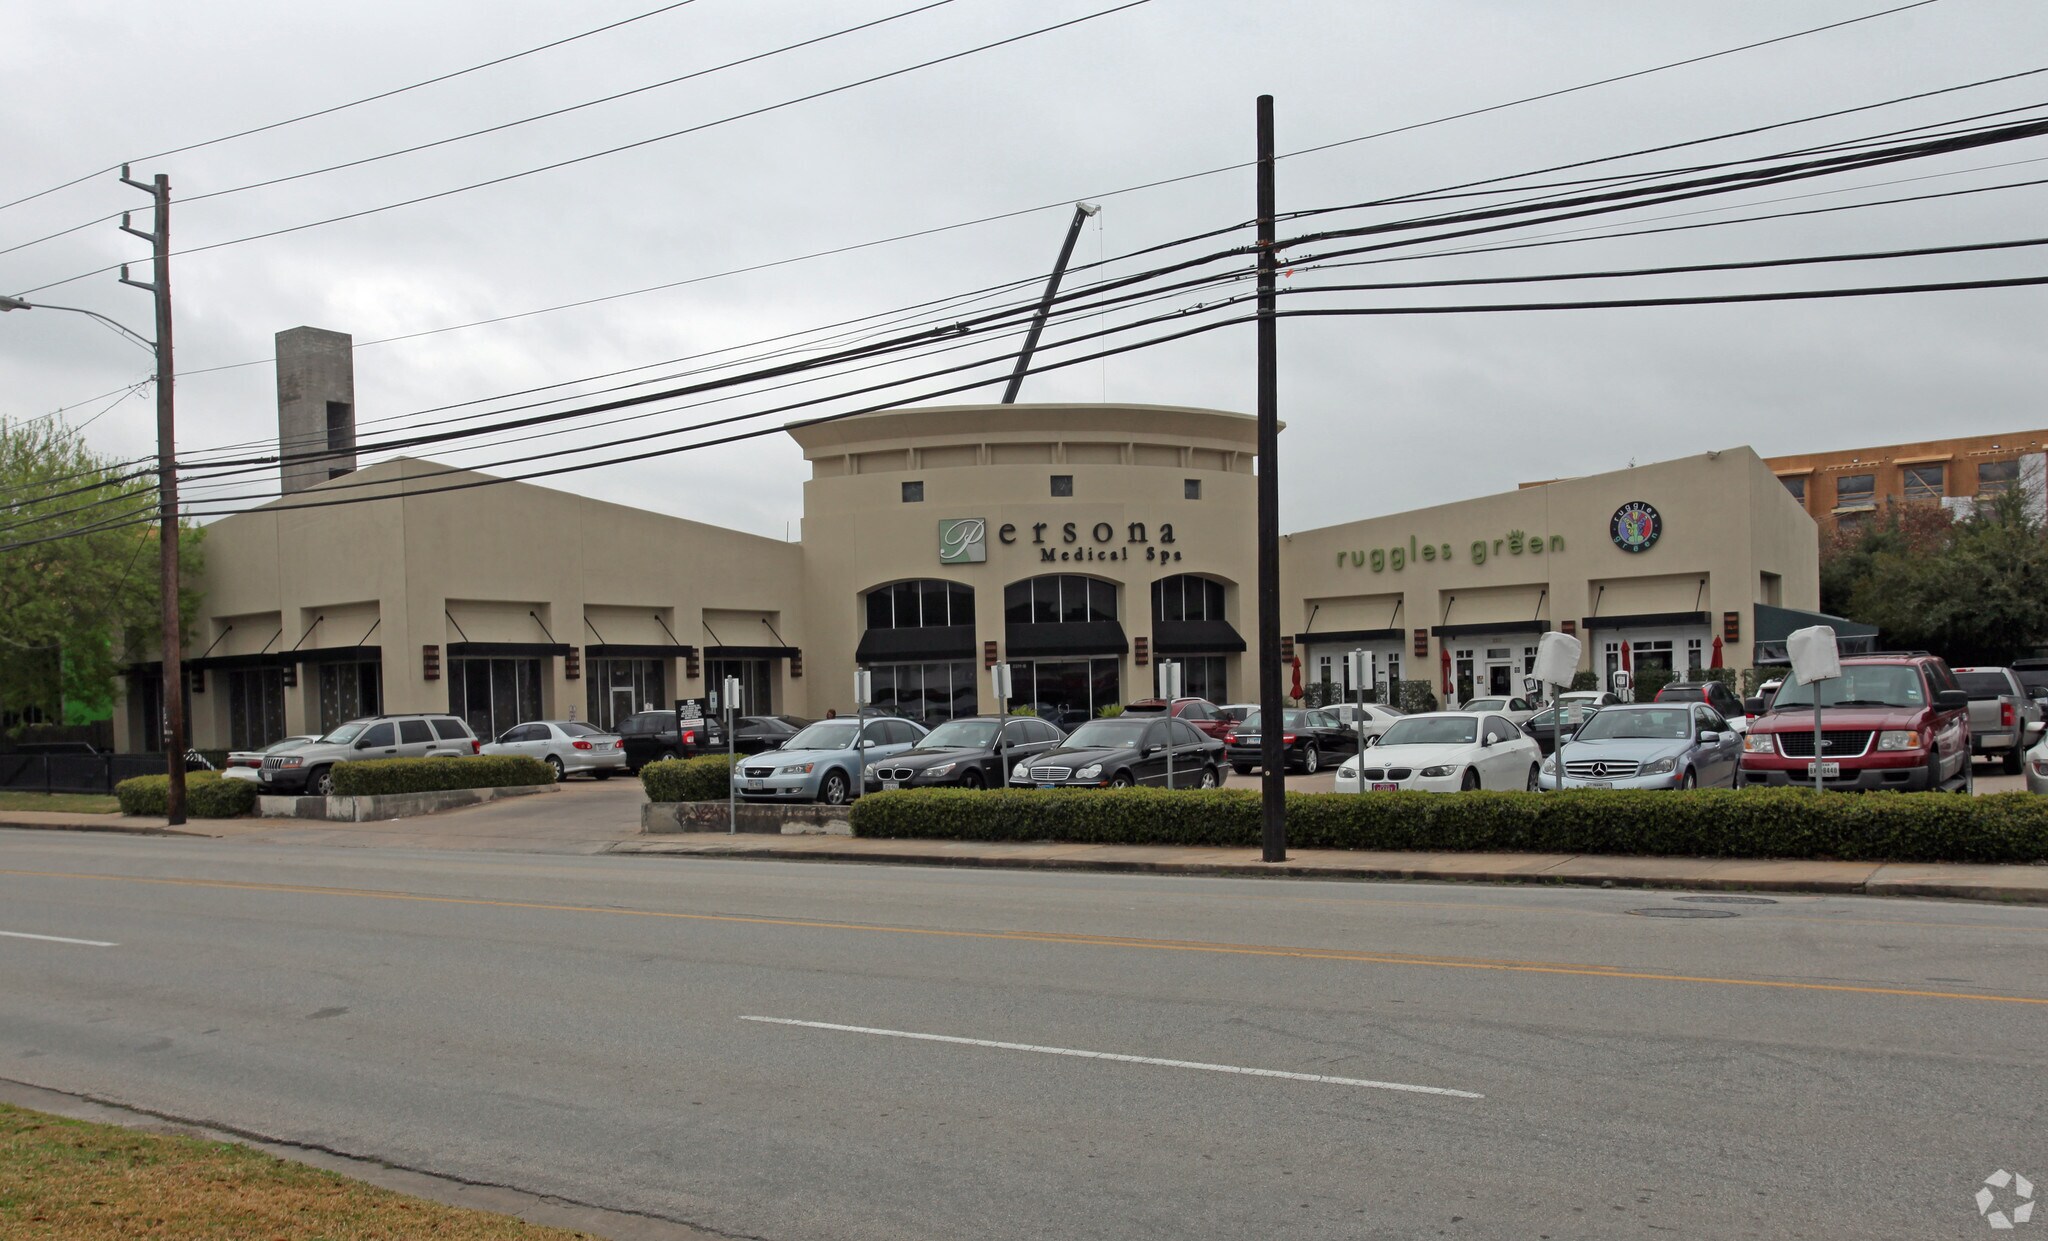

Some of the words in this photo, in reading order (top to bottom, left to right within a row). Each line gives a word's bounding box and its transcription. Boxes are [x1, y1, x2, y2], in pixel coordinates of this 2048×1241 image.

[1614, 503, 1657, 522] ruggles
[1614, 532, 1658, 552] green
[1041, 547, 1127, 562] Medical
[1147, 547, 1182, 565] Spa
[1337, 535, 1452, 572] ruggles
[1471, 532, 1565, 564] green
